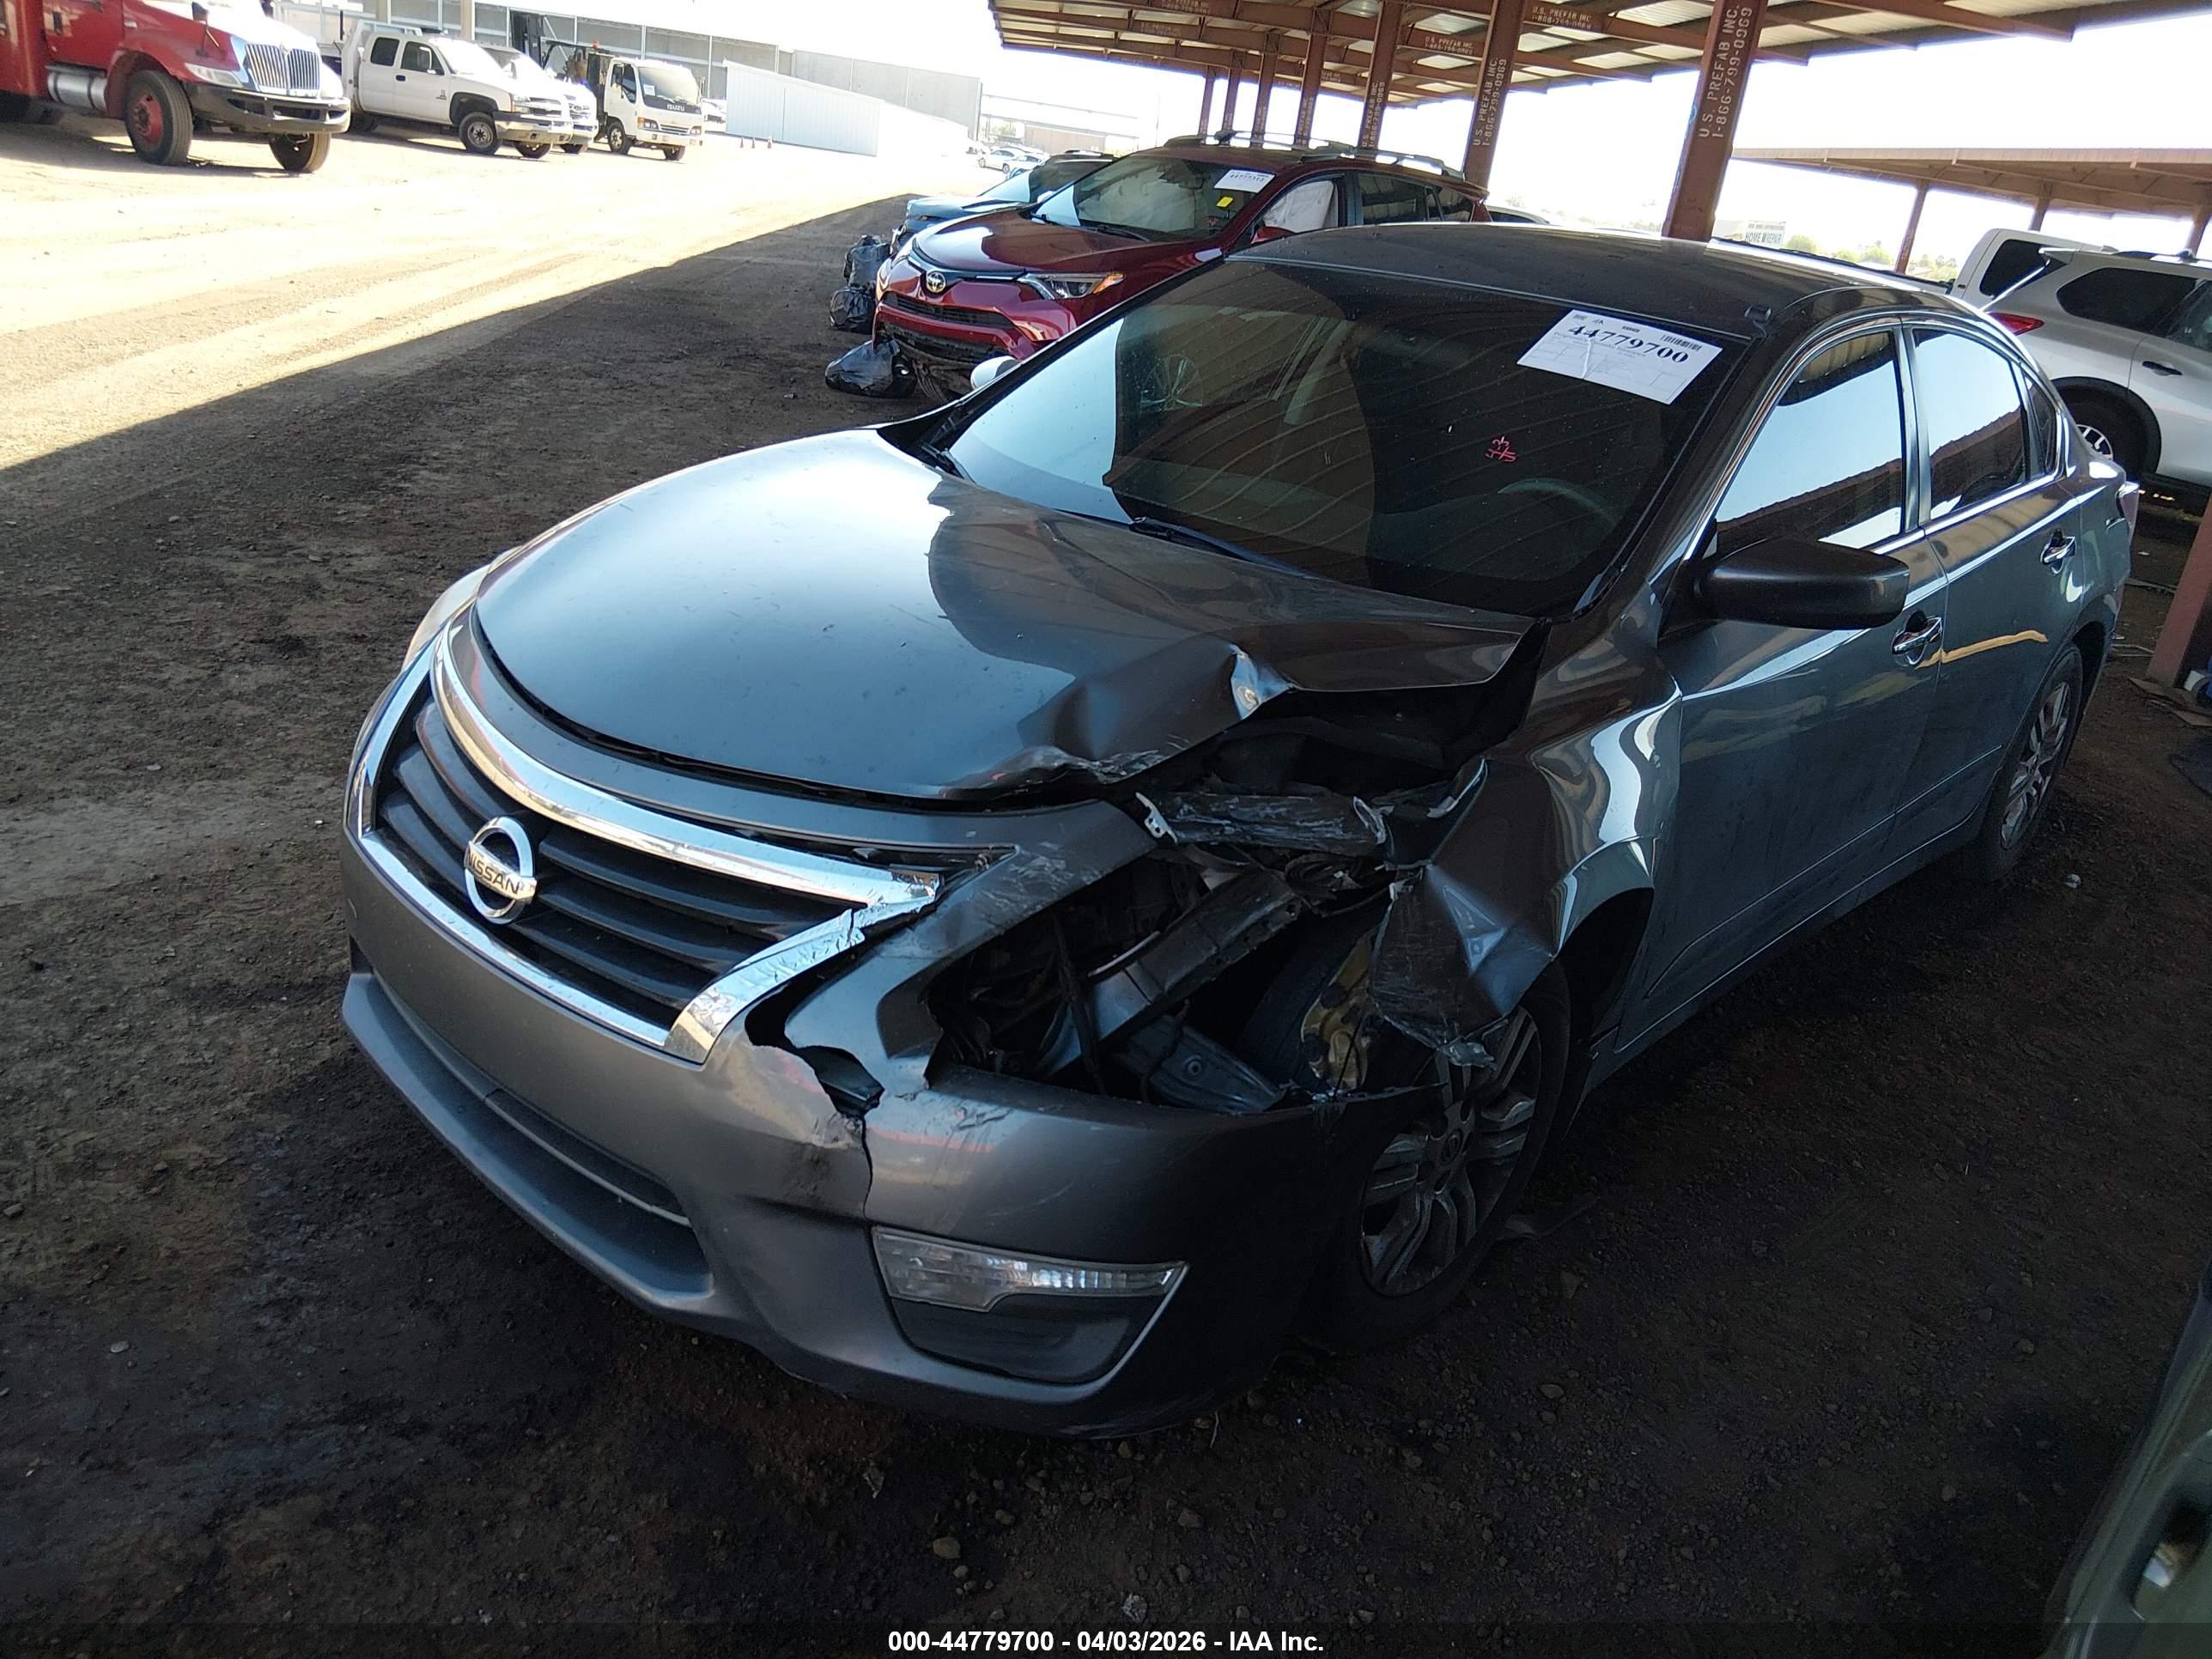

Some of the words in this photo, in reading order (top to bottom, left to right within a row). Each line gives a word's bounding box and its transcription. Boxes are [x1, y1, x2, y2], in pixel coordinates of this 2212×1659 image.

[1478, 82, 1494, 122] PREFAB
[1482, 58, 1507, 146] 1-866-799-0969
[1698, 110, 1716, 137] U.S.
[1707, 41, 1730, 100] PREFAB
[1723, 5, 1741, 33] INC.
[1711, 7, 1753, 137] 1-866-799-0969
[1568, 325, 1689, 363] 44779700
[466, 849, 520, 893] NISSAN
